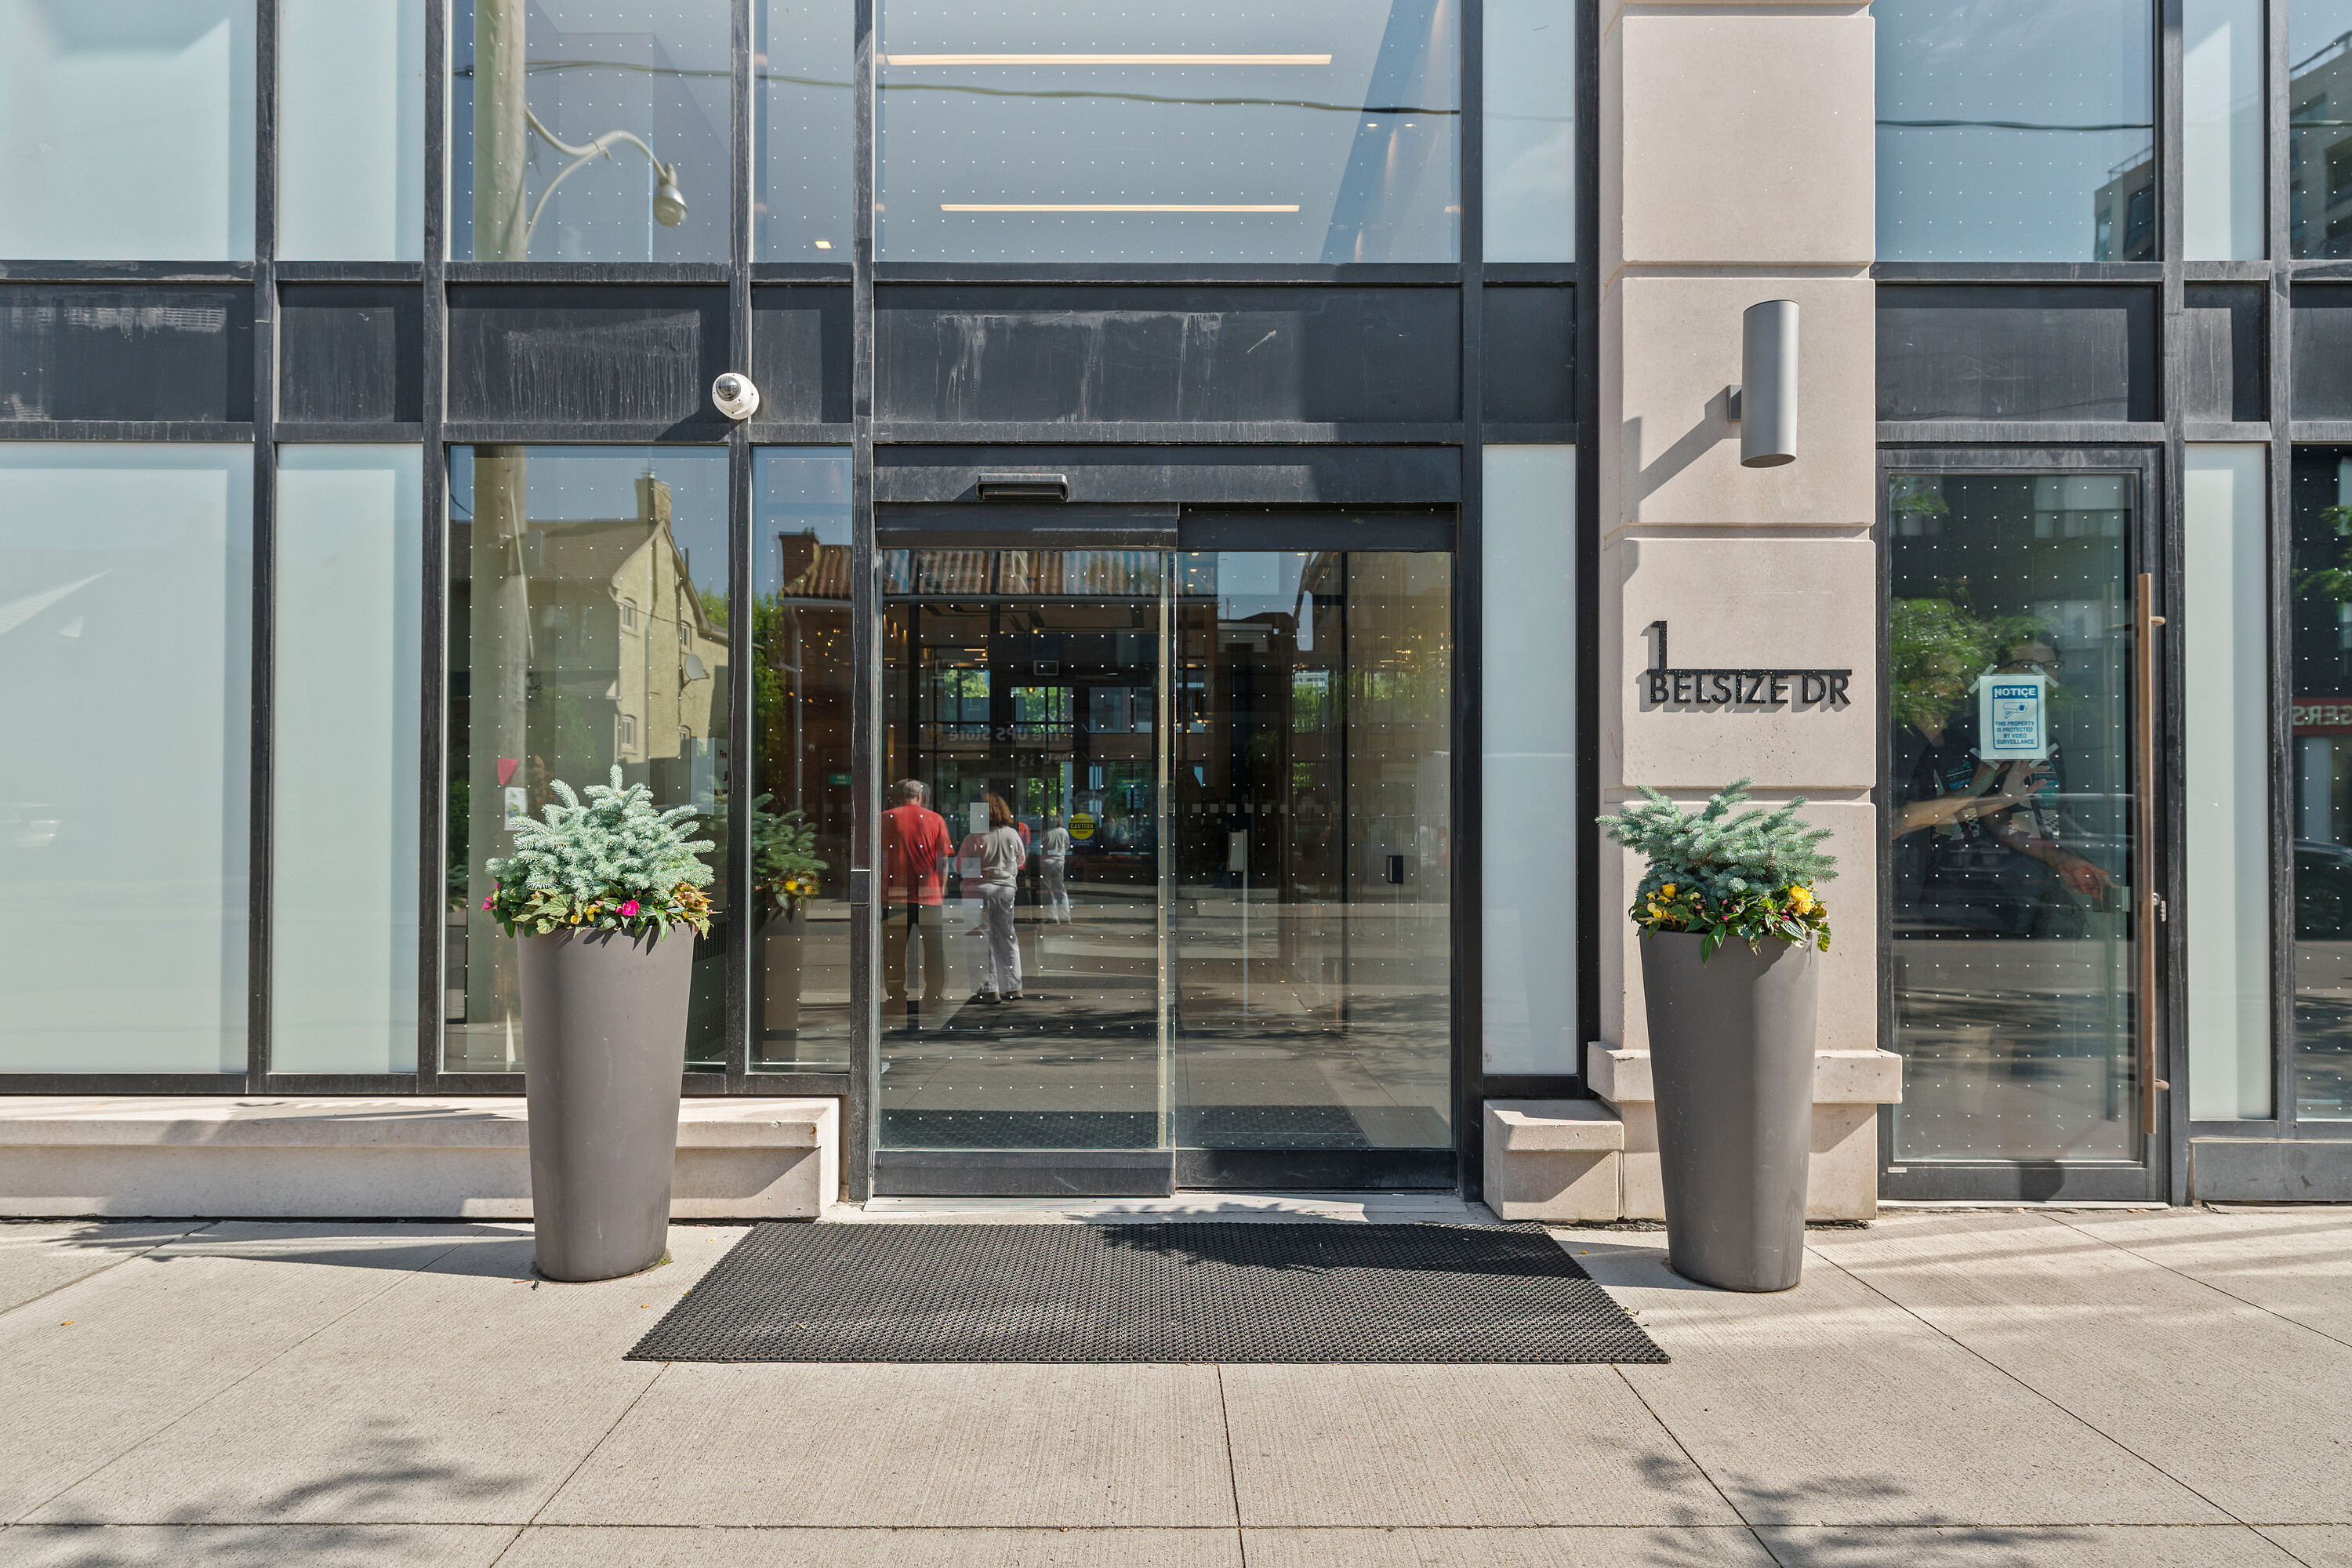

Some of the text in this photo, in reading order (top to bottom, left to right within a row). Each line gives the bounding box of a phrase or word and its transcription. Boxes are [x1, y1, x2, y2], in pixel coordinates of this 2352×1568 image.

[1651, 620, 1668, 669] 1
[1649, 669, 1852, 705] BELSIZE DR
